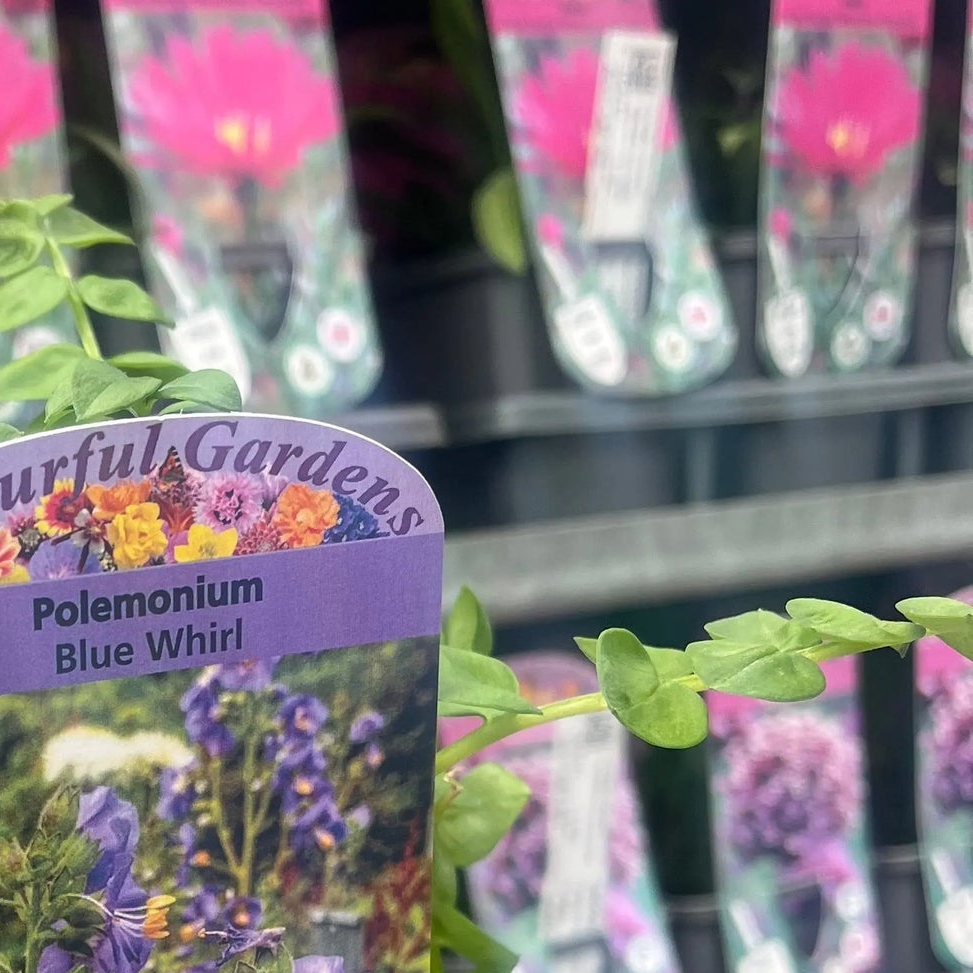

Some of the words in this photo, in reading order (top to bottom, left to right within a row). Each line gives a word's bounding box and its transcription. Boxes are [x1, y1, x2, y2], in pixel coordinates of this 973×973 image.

[183, 419, 425, 537] Gardens
[32, 574, 264, 631] Polemonium
[54, 636, 134, 675] Blue
[145, 617, 244, 661] Whirl
